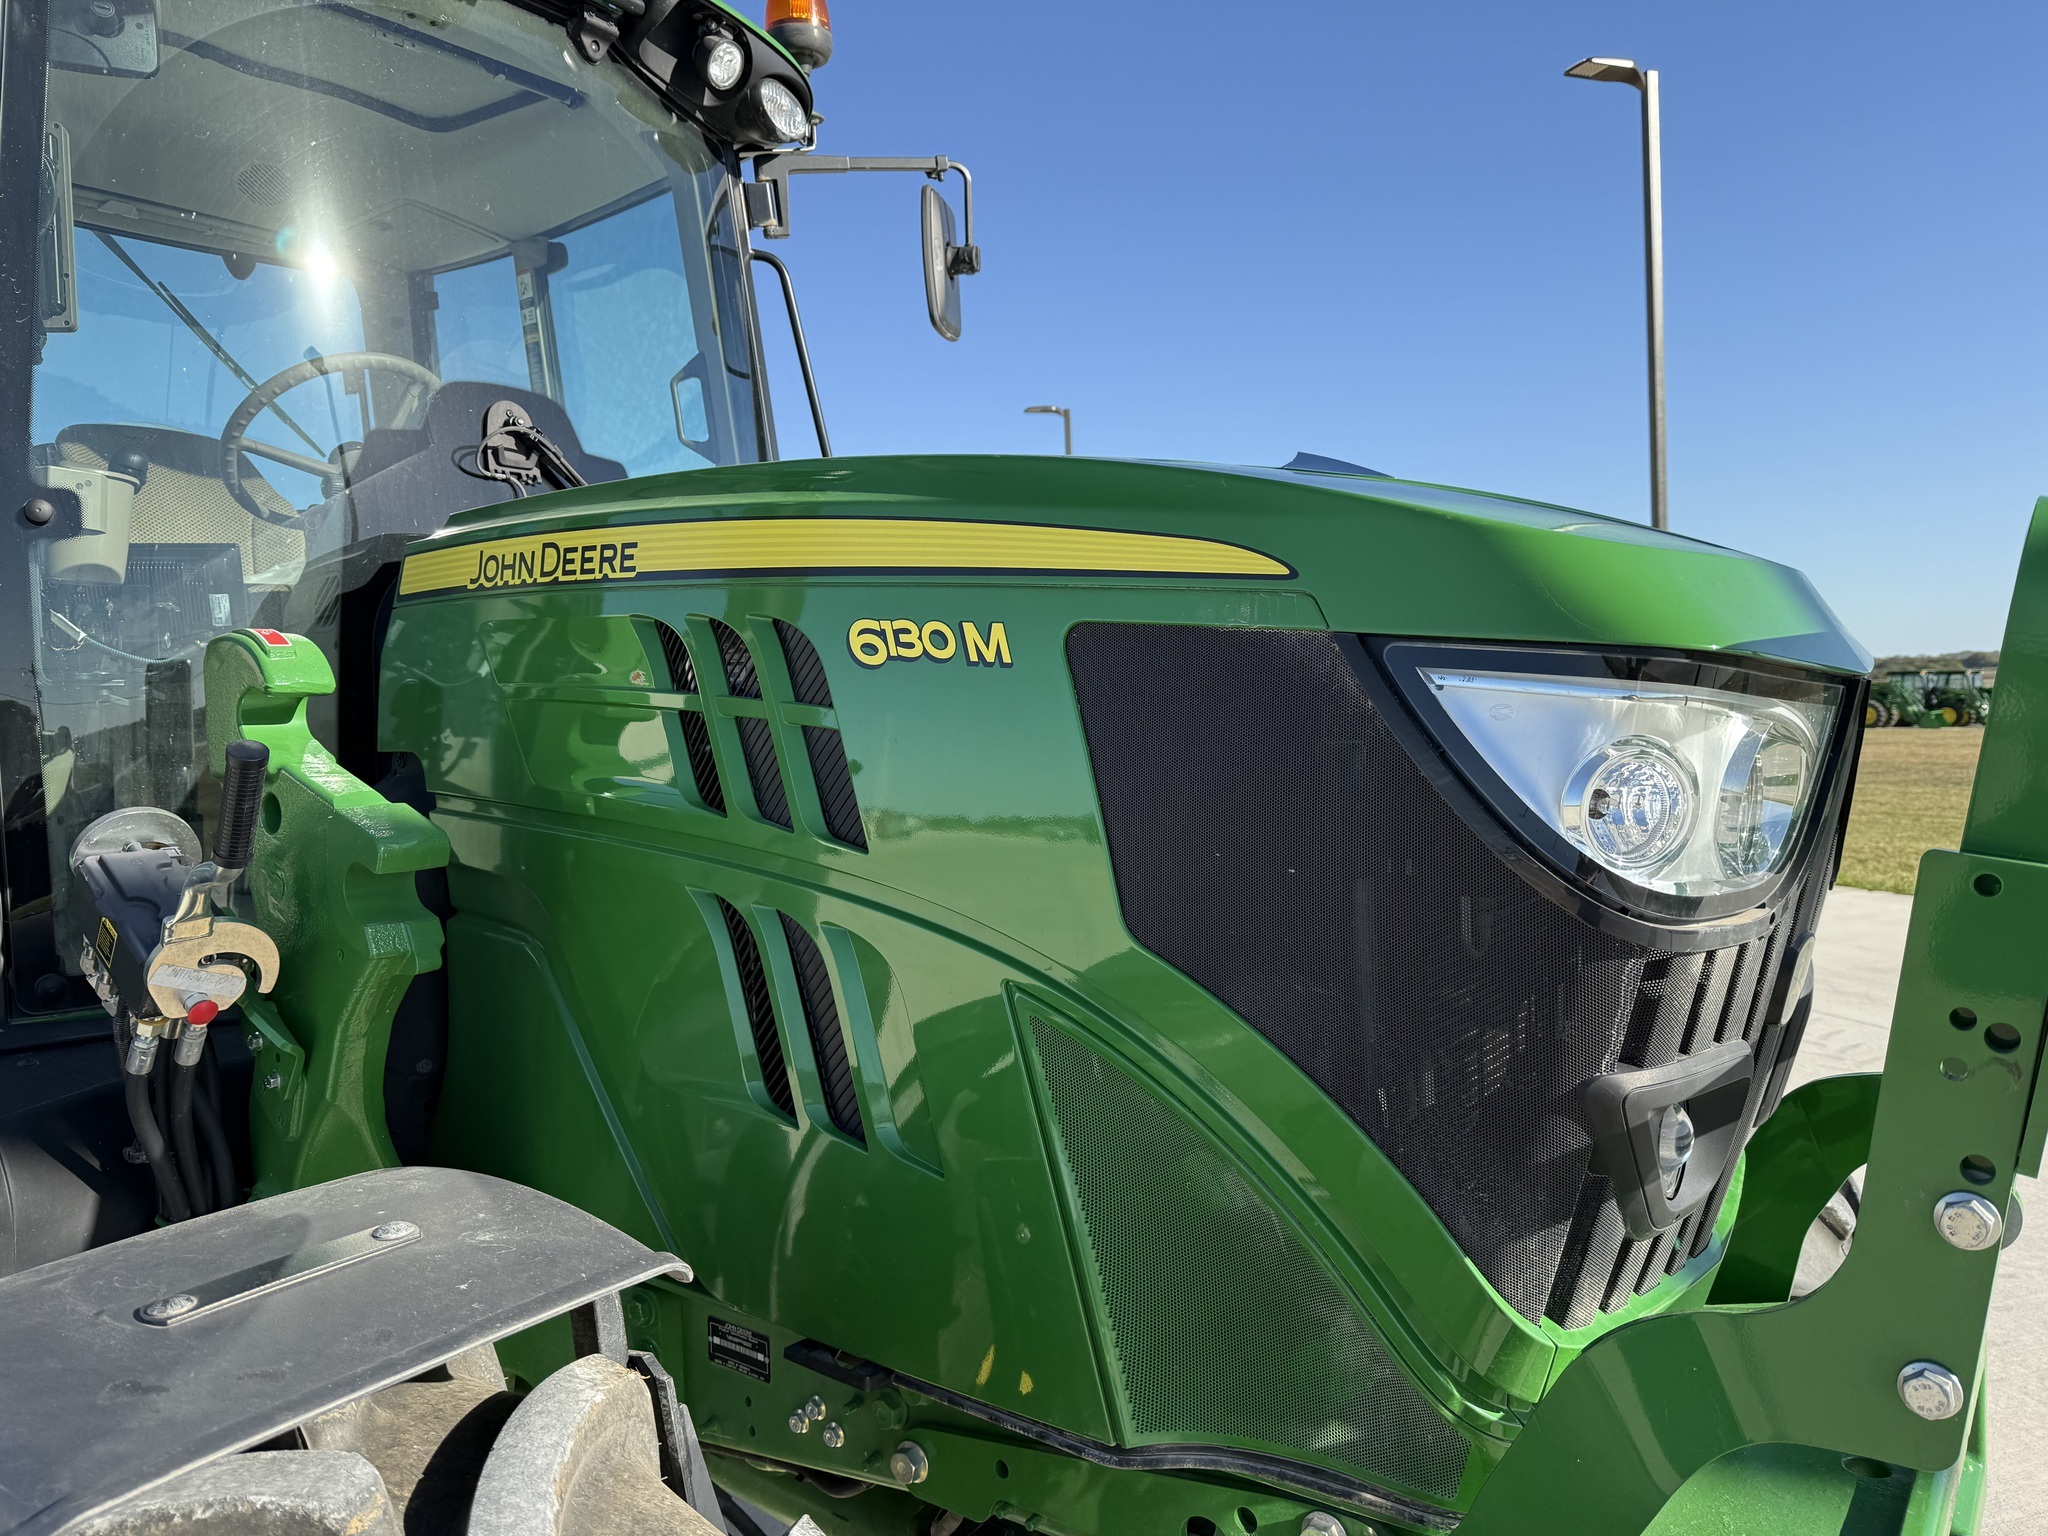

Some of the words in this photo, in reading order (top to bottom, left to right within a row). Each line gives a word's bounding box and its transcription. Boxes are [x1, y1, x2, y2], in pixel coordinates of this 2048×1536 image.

[468, 549, 536, 586] JOHN
[538, 541, 639, 580] DEERE
[847, 618, 957, 669] 6130
